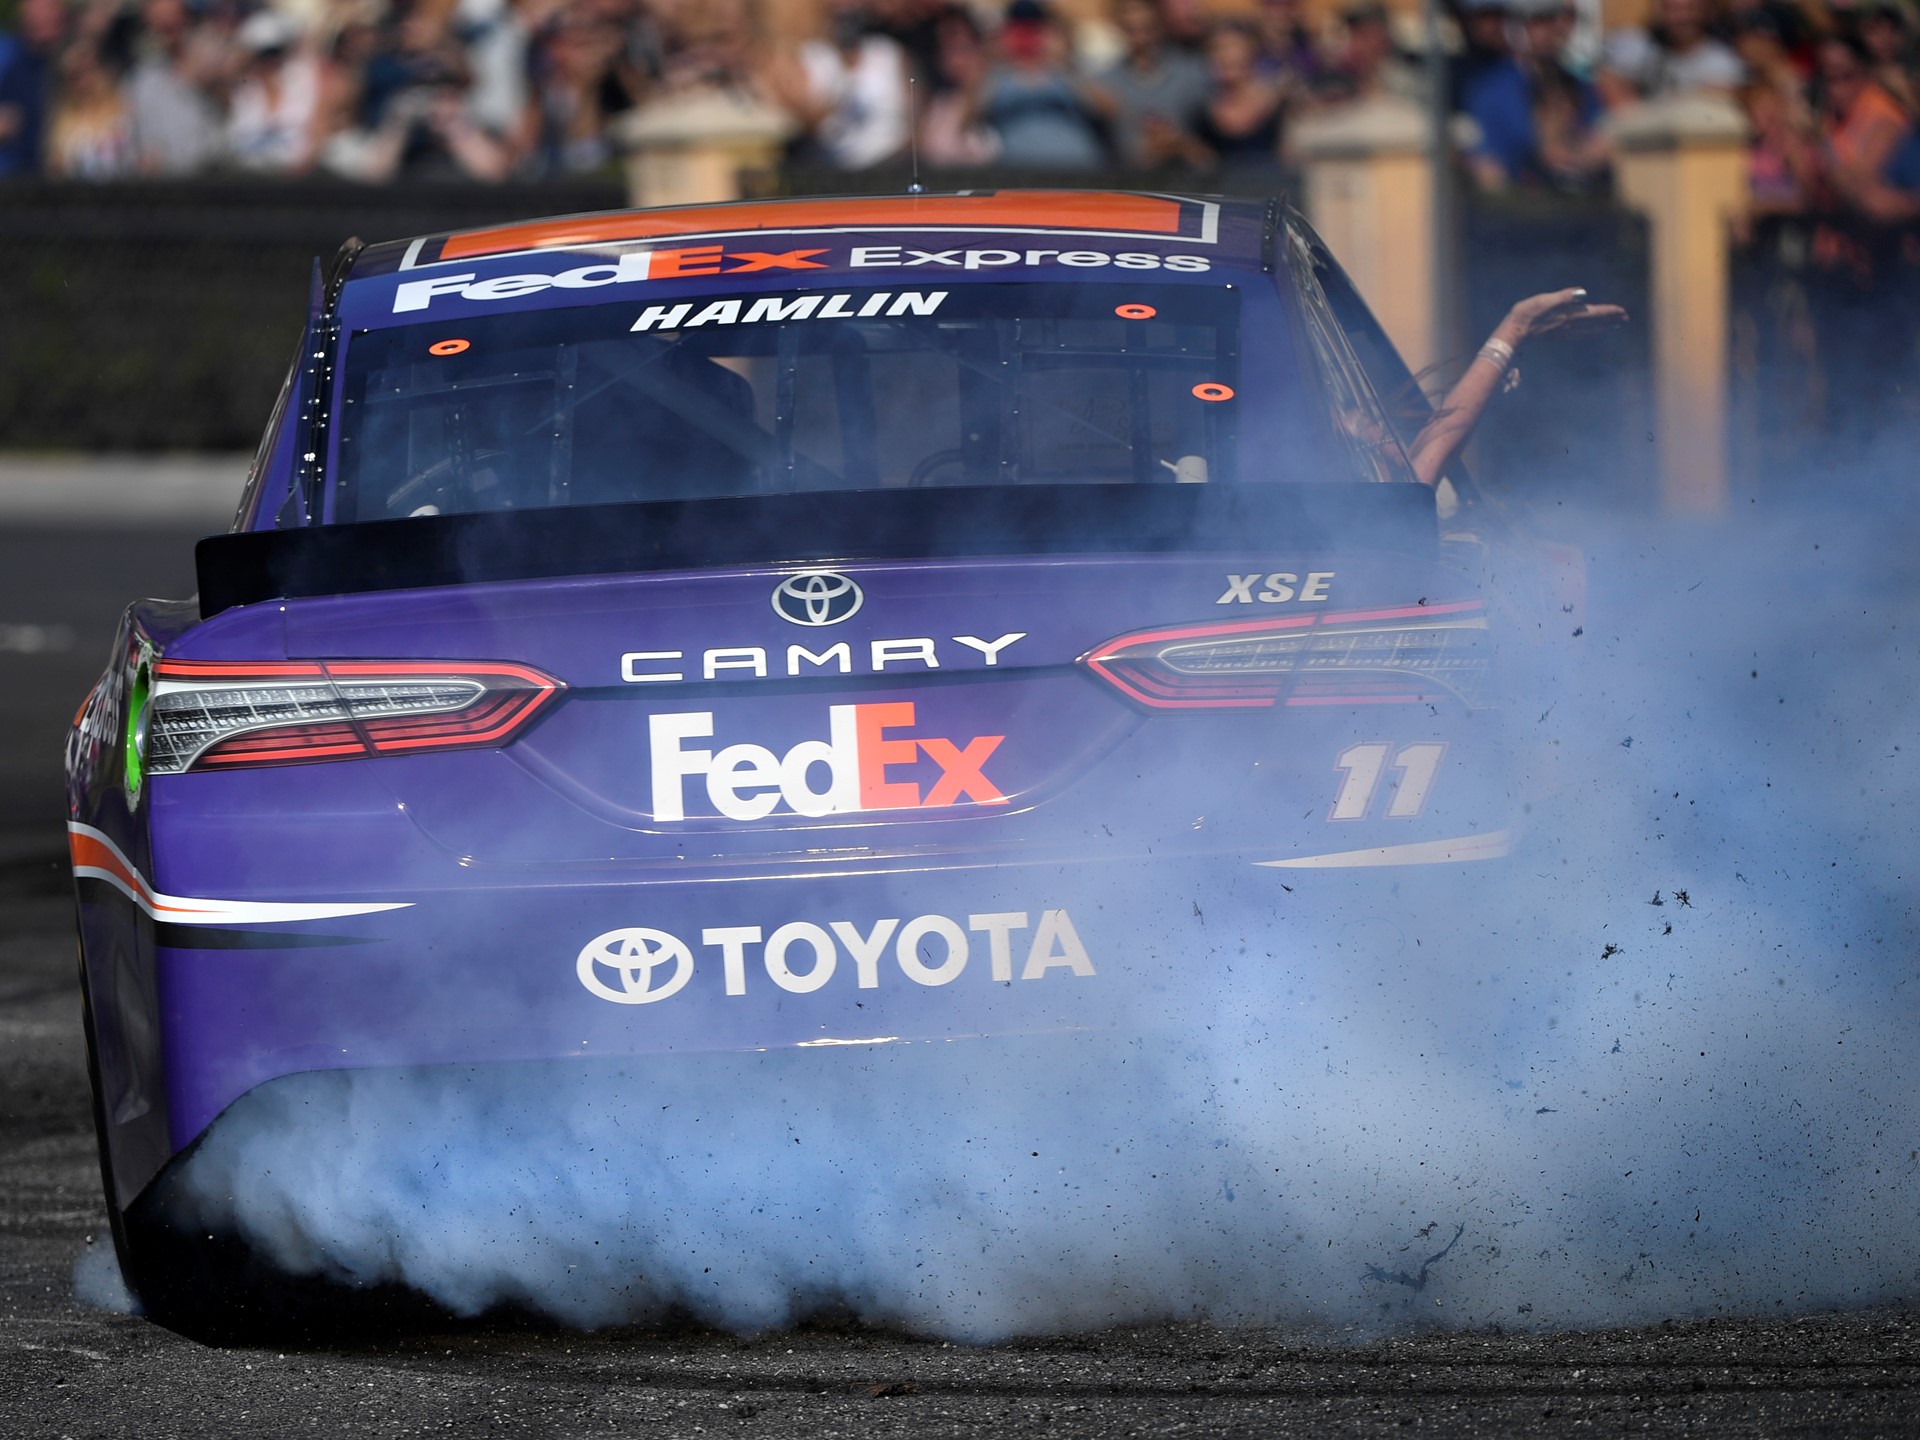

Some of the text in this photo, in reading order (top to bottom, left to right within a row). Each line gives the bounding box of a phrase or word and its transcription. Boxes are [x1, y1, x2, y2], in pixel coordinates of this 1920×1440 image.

[393, 245, 1211, 313] FedEx Express
[630, 291, 948, 332] HAMLIN
[1216, 572, 1336, 605] XSE
[621, 632, 1027, 683] CAMRY
[649, 702, 1010, 823] FedEx
[1327, 741, 1448, 822] 11
[702, 909, 1097, 996] TOYOTA
